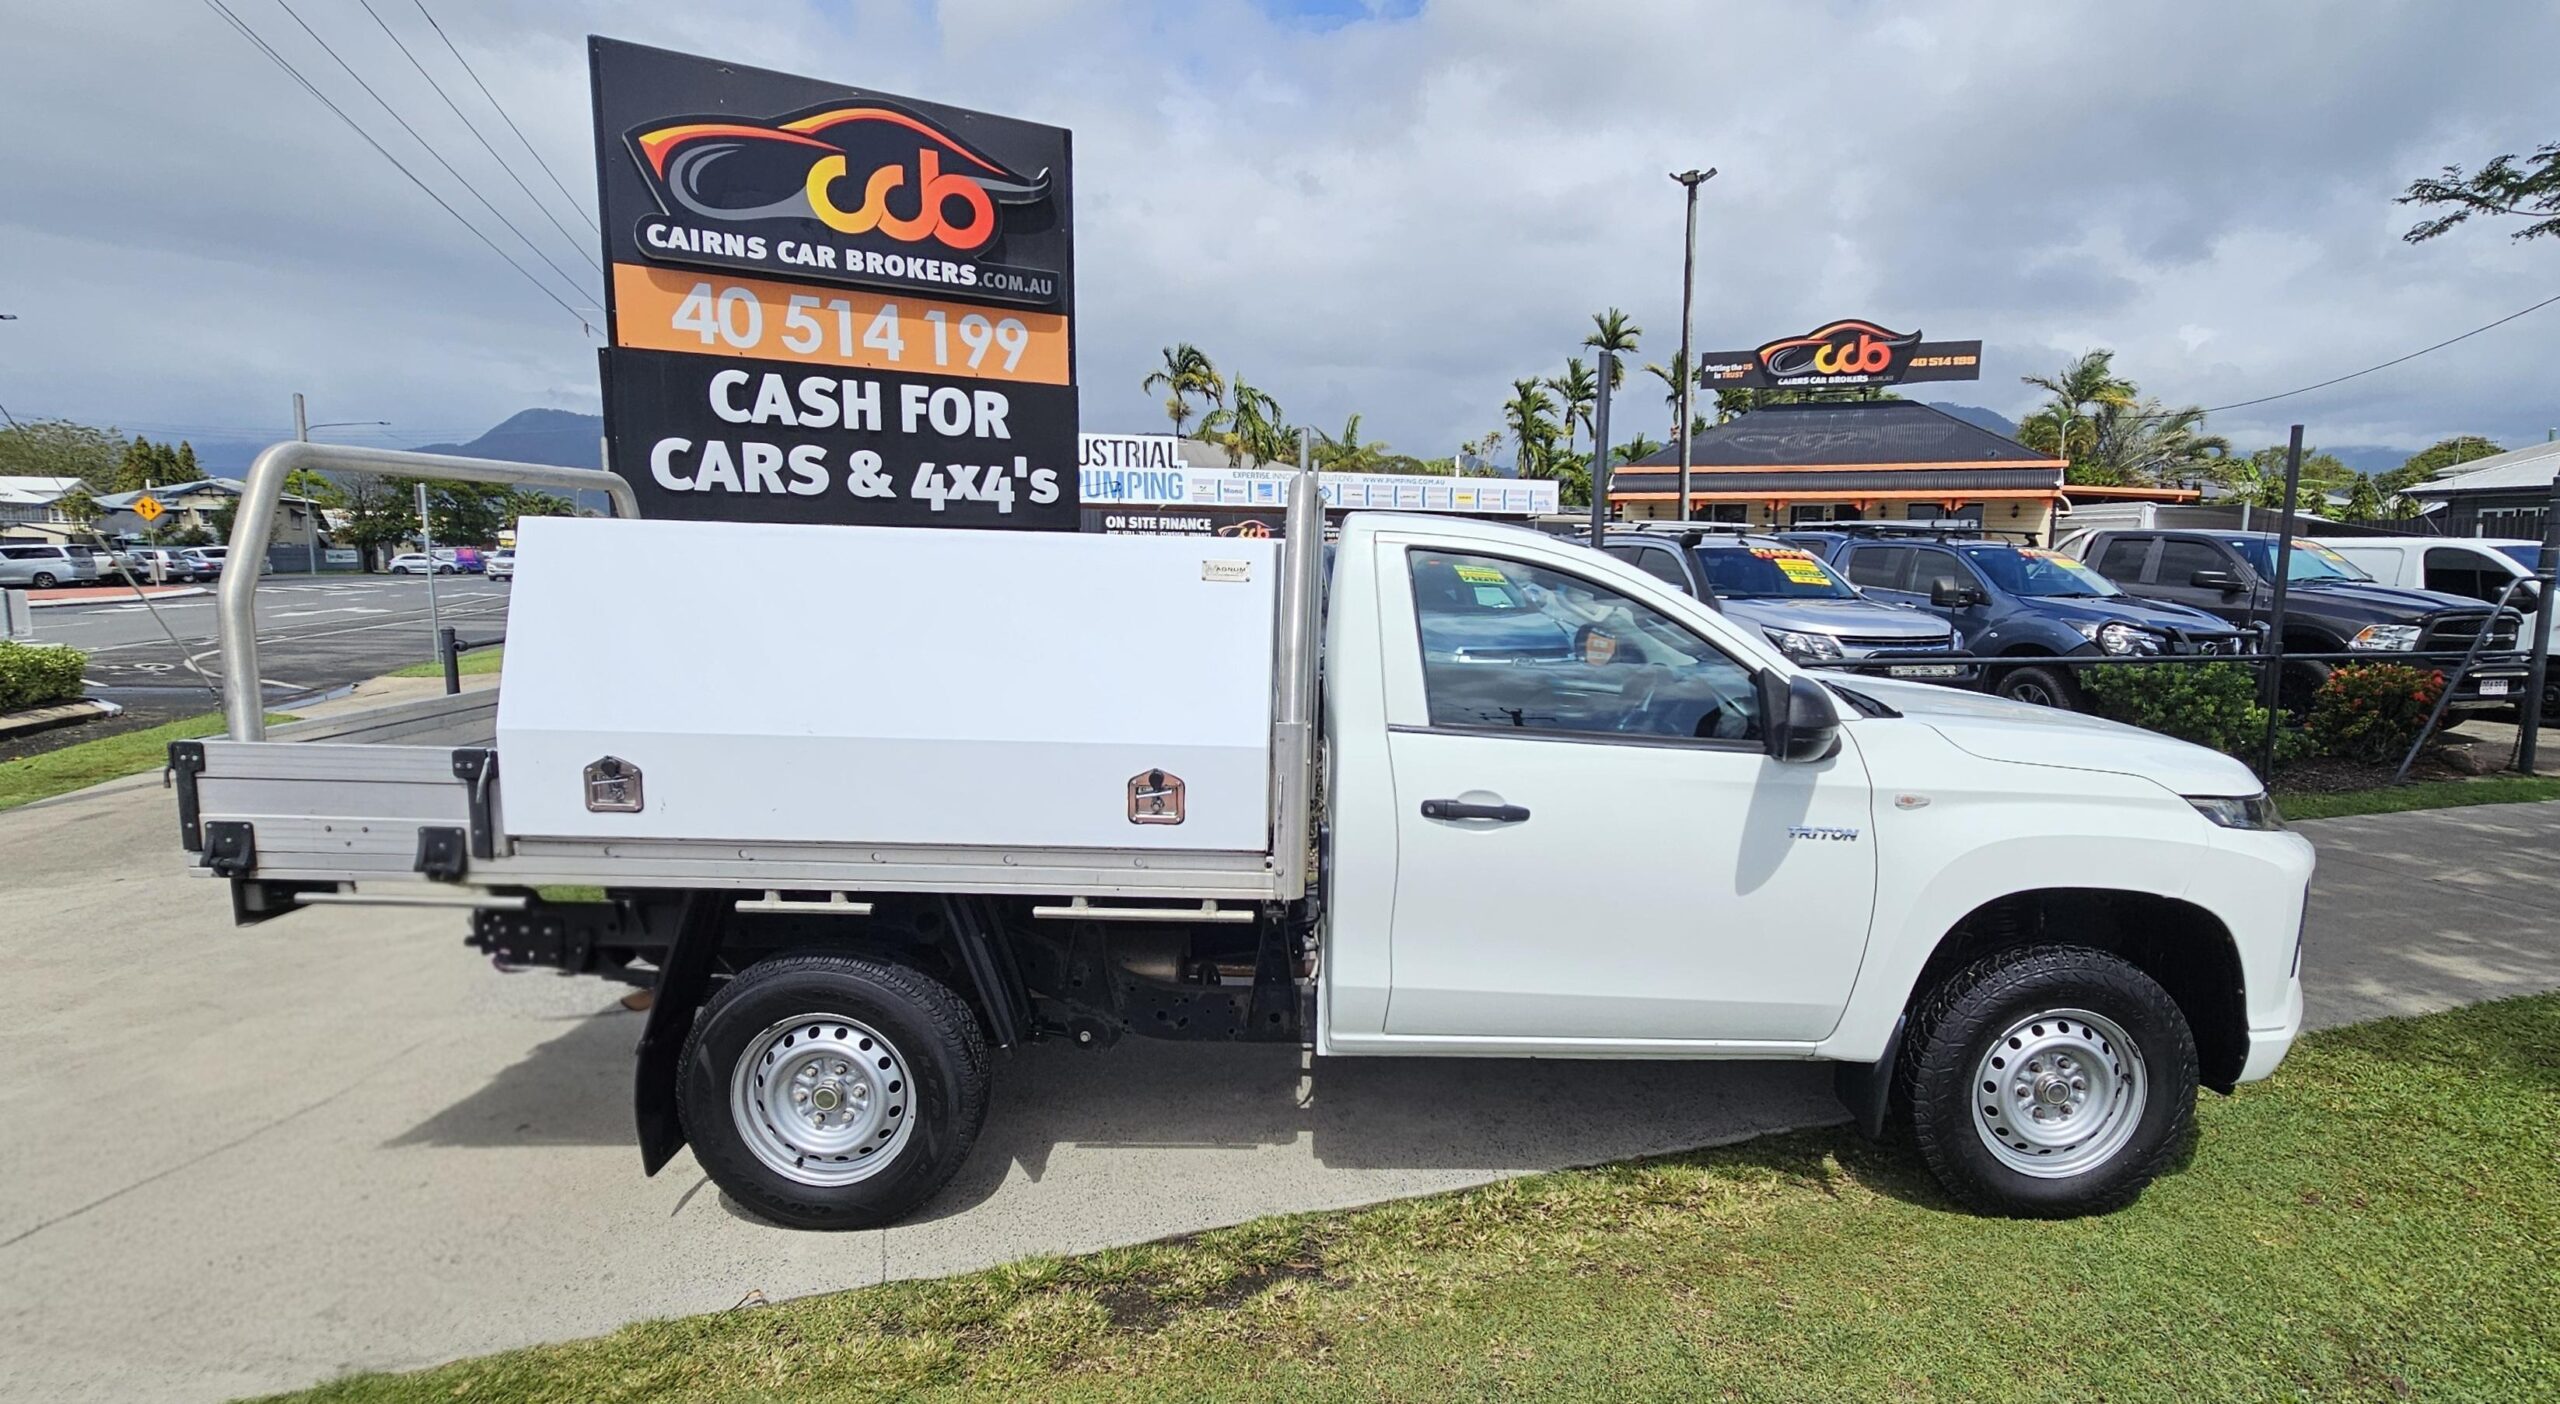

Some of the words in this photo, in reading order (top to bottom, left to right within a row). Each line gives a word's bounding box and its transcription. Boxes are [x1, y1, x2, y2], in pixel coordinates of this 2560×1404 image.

[646, 223, 767, 260] CAIRNS
[777, 239, 836, 269] CAR
[671, 282, 763, 349] 40
[781, 295, 904, 363] 514
[924, 310, 1029, 373] 199
[1705, 365, 1730, 373] Putting
[1731, 363, 1742, 371] the
[1778, 377, 1809, 385] CAIRNS
[1810, 376, 1827, 384] CAR
[709, 369, 882, 432] CASH
[901, 384, 1010, 440] FOR
[650, 437, 830, 496] CARS
[847, 450, 896, 498] &
[1232, 471, 1270, 480] EXPERTISE
[1080, 470, 1184, 500] UMPING
[1105, 515, 1126, 529] ON
[1128, 517, 1157, 529] SITE
[1159, 517, 1212, 530] FINANCE
[1787, 826, 1859, 842] TRITON
